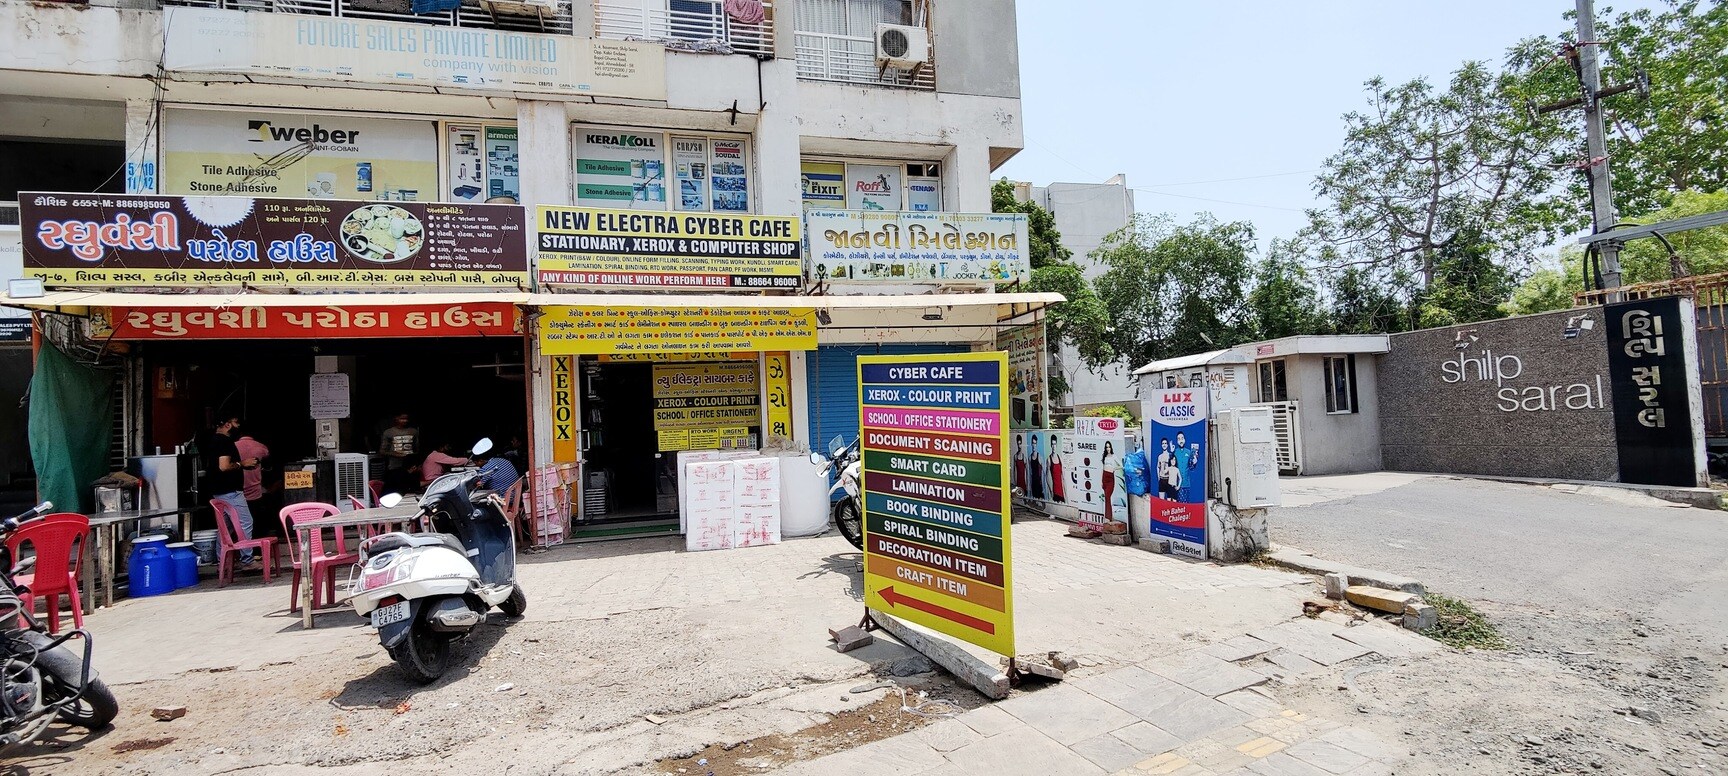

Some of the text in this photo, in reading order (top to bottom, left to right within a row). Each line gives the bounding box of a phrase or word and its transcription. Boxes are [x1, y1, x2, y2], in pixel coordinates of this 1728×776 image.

[297, 19, 557, 62] FUTURE SALES PRIVATE LIMITED
[423, 58, 558, 77] company with vision
[271, 124, 359, 144] weber
[586, 134, 656, 147] KERAKOLL
[128, 162, 154, 176] 5 10
[202, 165, 278, 177] Tile Adhesive
[585, 163, 625, 172] Tile Adhesive
[127, 176, 154, 190] 11 12
[190, 181, 278, 193] Stone Adhesive
[812, 186, 838, 194] FIXIT
[856, 180, 881, 192] Roff
[911, 185, 935, 193] TENAX
[585, 188, 604, 196] Stone
[34, 196, 170, 209] કૌશિક 8866985050
[264, 204, 280, 212] 110
[545, 210, 792, 238] NEW ELECTRA CYBER CAFE
[38, 211, 182, 262] રઘુવંશી
[824, 223, 901, 249] જાનવી
[186, 228, 339, 263] પરોઠા હાઉસ
[541, 234, 796, 256] STATIONARY, XEROX & COMPUTER SHOP
[75, 270, 107, 282] શિલ્પ
[153, 271, 187, 283] કબીર
[261, 272, 289, 284] સામે,
[419, 272, 457, 283] સ્ટોપની
[461, 273, 486, 284] પાસે,
[542, 272, 798, 287] ANY KIND OF ONLINE WORK PERFORM HERE M.: 88664 96006
[952, 272, 978, 280] JOCKEY
[282, 305, 502, 329] પરોઠા હાઉસ
[1621, 308, 1667, 360] શિલ્પ
[889, 367, 963, 379] CYBER CAFE
[1441, 350, 1523, 388] shilp
[704, 374, 736, 384] સાયબર
[554, 356, 571, 441] XEROX
[868, 390, 900, 401] XEROX
[908, 390, 953, 403] COLOUR
[955, 391, 991, 404] PRINT
[1163, 392, 1193, 403] LUX
[1497, 374, 1604, 413] saral
[1631, 365, 1667, 429] સરલ
[657, 395, 756, 408] XEROX COLOUR PRINT
[656, 408, 757, 420] SCHOOL OFFICE STATIONERY
[1159, 405, 1196, 417] CLASSIC
[868, 412, 899, 425] SCHOOL
[905, 414, 934, 428] OFFICE
[936, 416, 993, 431] STATIONERY
[869, 433, 993, 455] DOCUMENT SCANING
[1077, 442, 1097, 451] SAREE
[890, 457, 967, 477] SMART CARD
[892, 479, 965, 501] LAMINATION
[886, 499, 973, 527] BOOK BINDING
[1161, 506, 1186, 517] Yeh Bahot
[1168, 512, 1192, 523] Chalega!
[884, 520, 979, 551] SPIRAL BINDING
[879, 540, 987, 578] DECORATION ITEM
[896, 566, 967, 597] CRAFT ITEM
[378, 611, 403, 626] C4765
